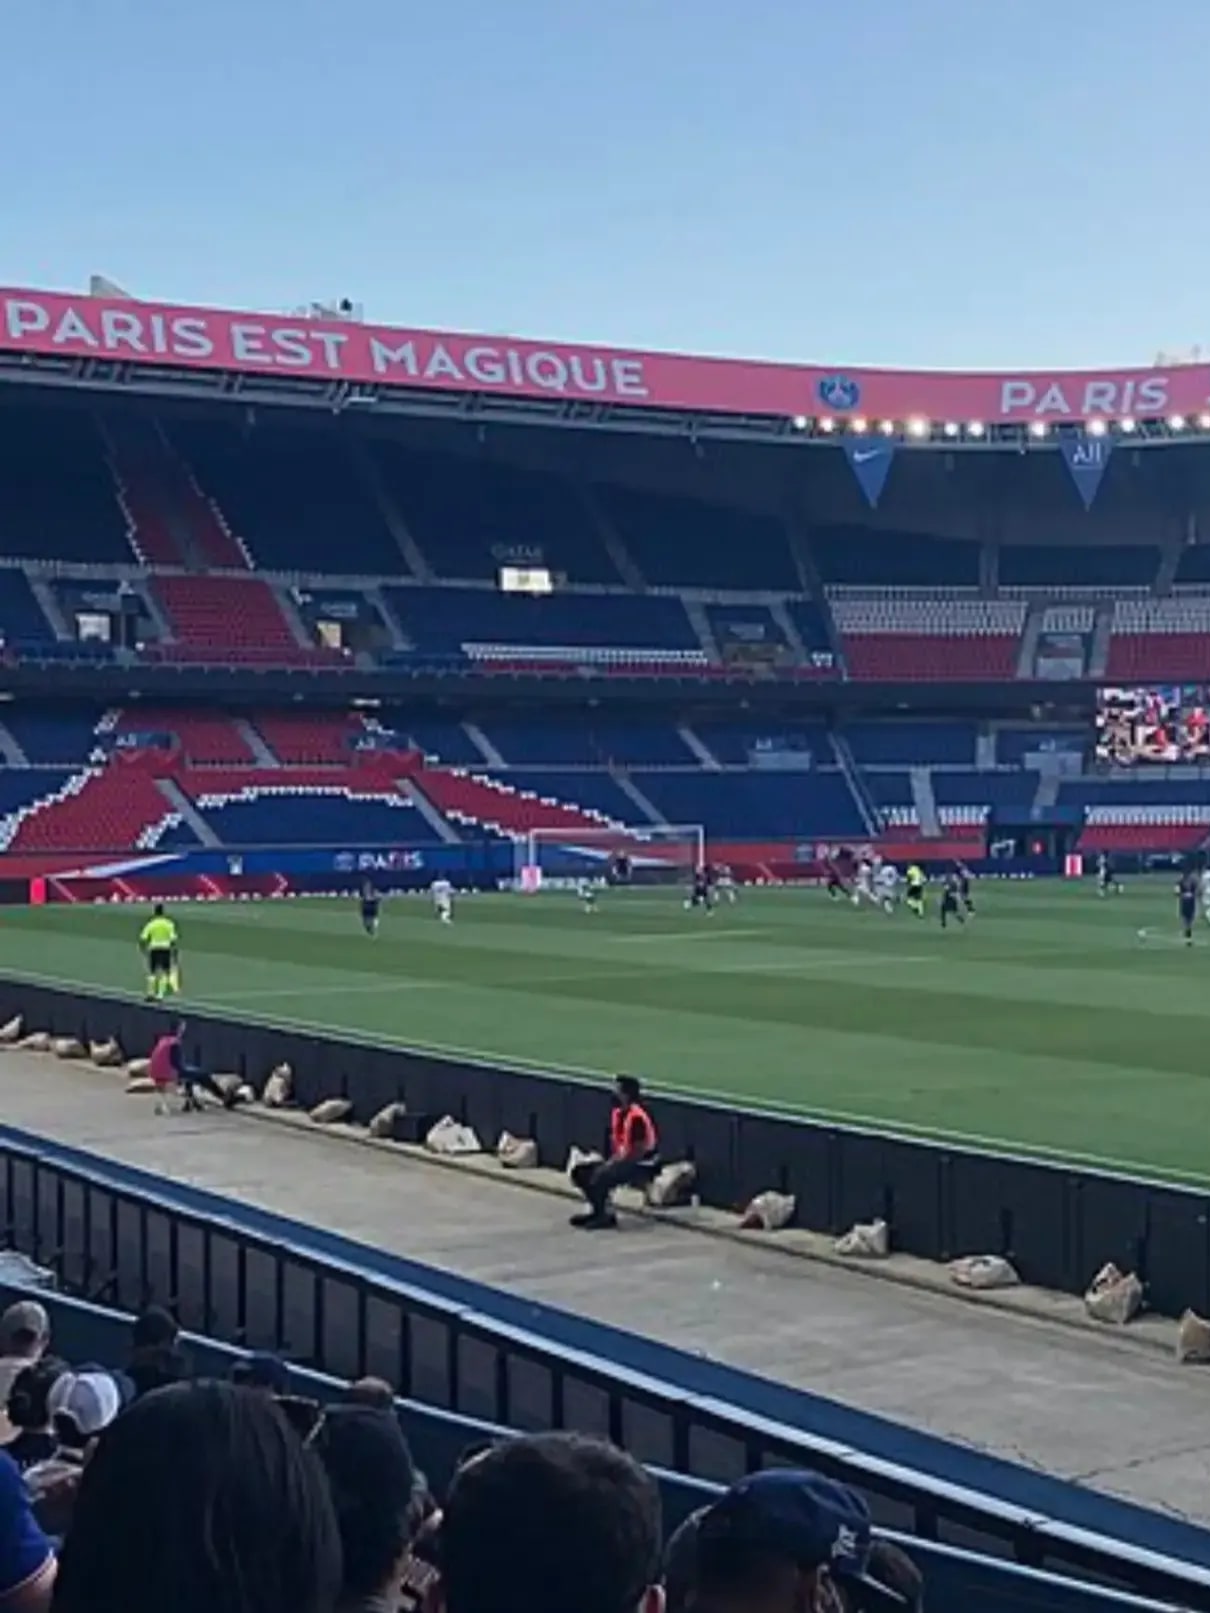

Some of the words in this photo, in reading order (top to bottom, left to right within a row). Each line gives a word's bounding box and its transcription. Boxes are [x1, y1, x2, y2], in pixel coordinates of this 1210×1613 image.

[5, 299, 213, 358] PARIS
[230, 322, 349, 369] EST
[369, 336, 649, 396] MAGIQUE
[1001, 378, 1169, 414] PARIS
